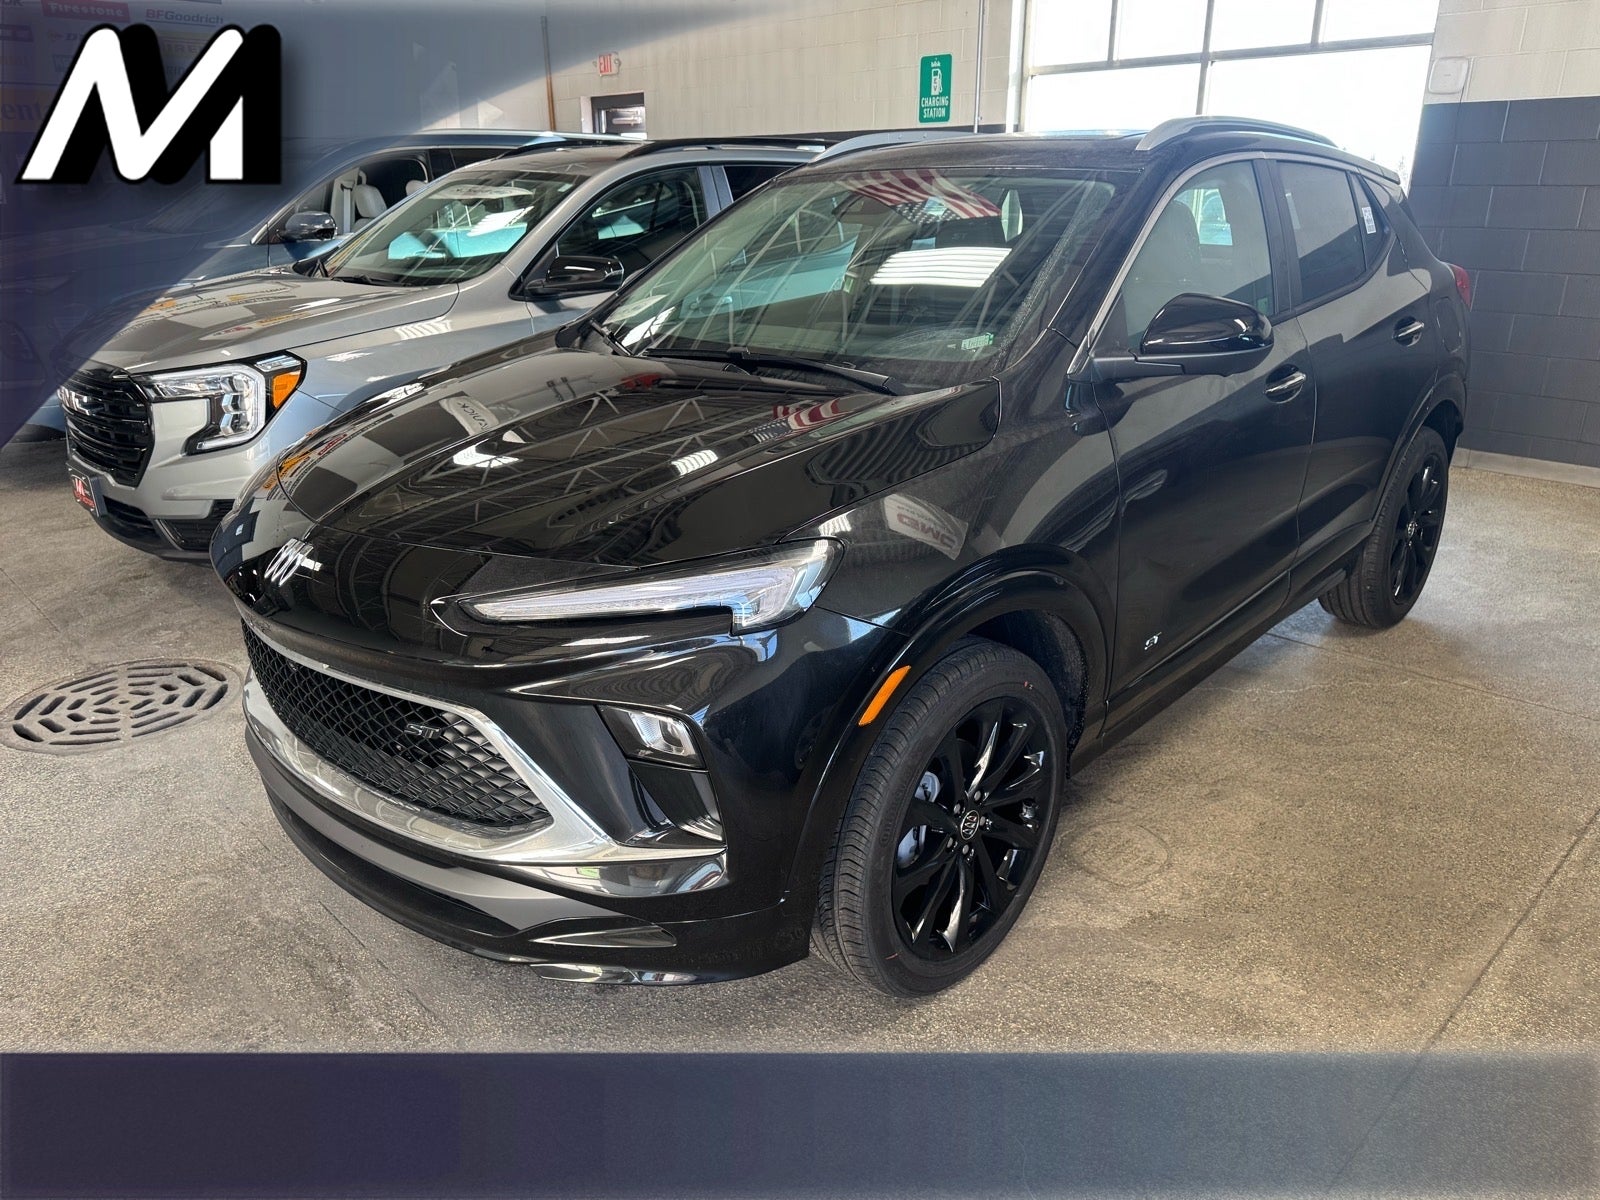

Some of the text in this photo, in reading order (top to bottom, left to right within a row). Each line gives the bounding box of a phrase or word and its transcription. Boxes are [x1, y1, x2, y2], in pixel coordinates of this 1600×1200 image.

[47, 2, 124, 17] Firestone
[146, 8, 224, 24] BFGoodrich
[599, 54, 612, 73] EXIT
[921, 96, 949, 108] CHARGING
[923, 107, 946, 118] STATION
[404, 723, 440, 738] ST
